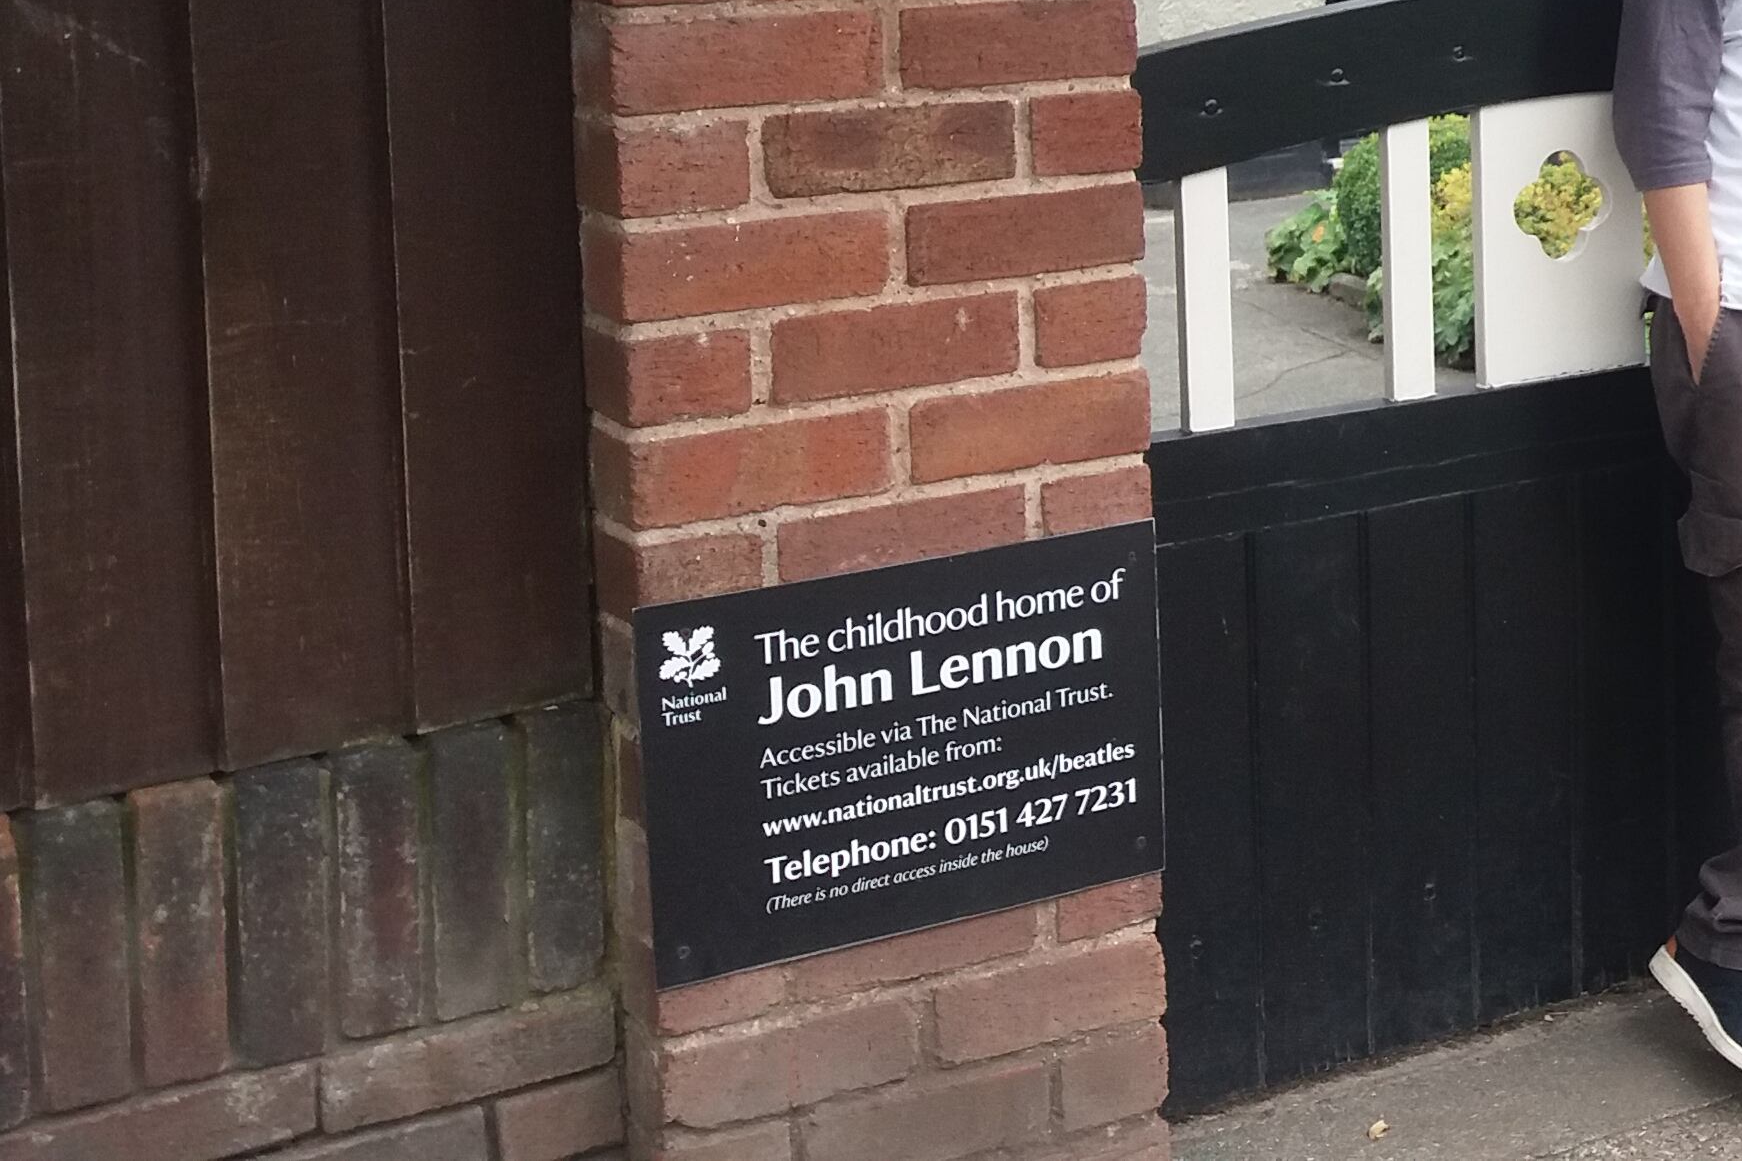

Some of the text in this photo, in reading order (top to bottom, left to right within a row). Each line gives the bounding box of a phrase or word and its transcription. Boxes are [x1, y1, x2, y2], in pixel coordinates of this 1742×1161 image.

[754, 568, 1126, 664] The childhood home of
[662, 687, 726, 711] National
[662, 710, 701, 726] Trust
[758, 629, 1102, 724] John Lennon
[760, 683, 1113, 768] Accessible via The National Trust.
[760, 737, 1001, 798] Tickets available from:
[763, 743, 1135, 836] www.nationaltrust.org.uk/beatles
[764, 778, 1136, 883] Telephone: 0151 427 7231
[767, 836, 1048, 913] (There is no direct access inside the house)
